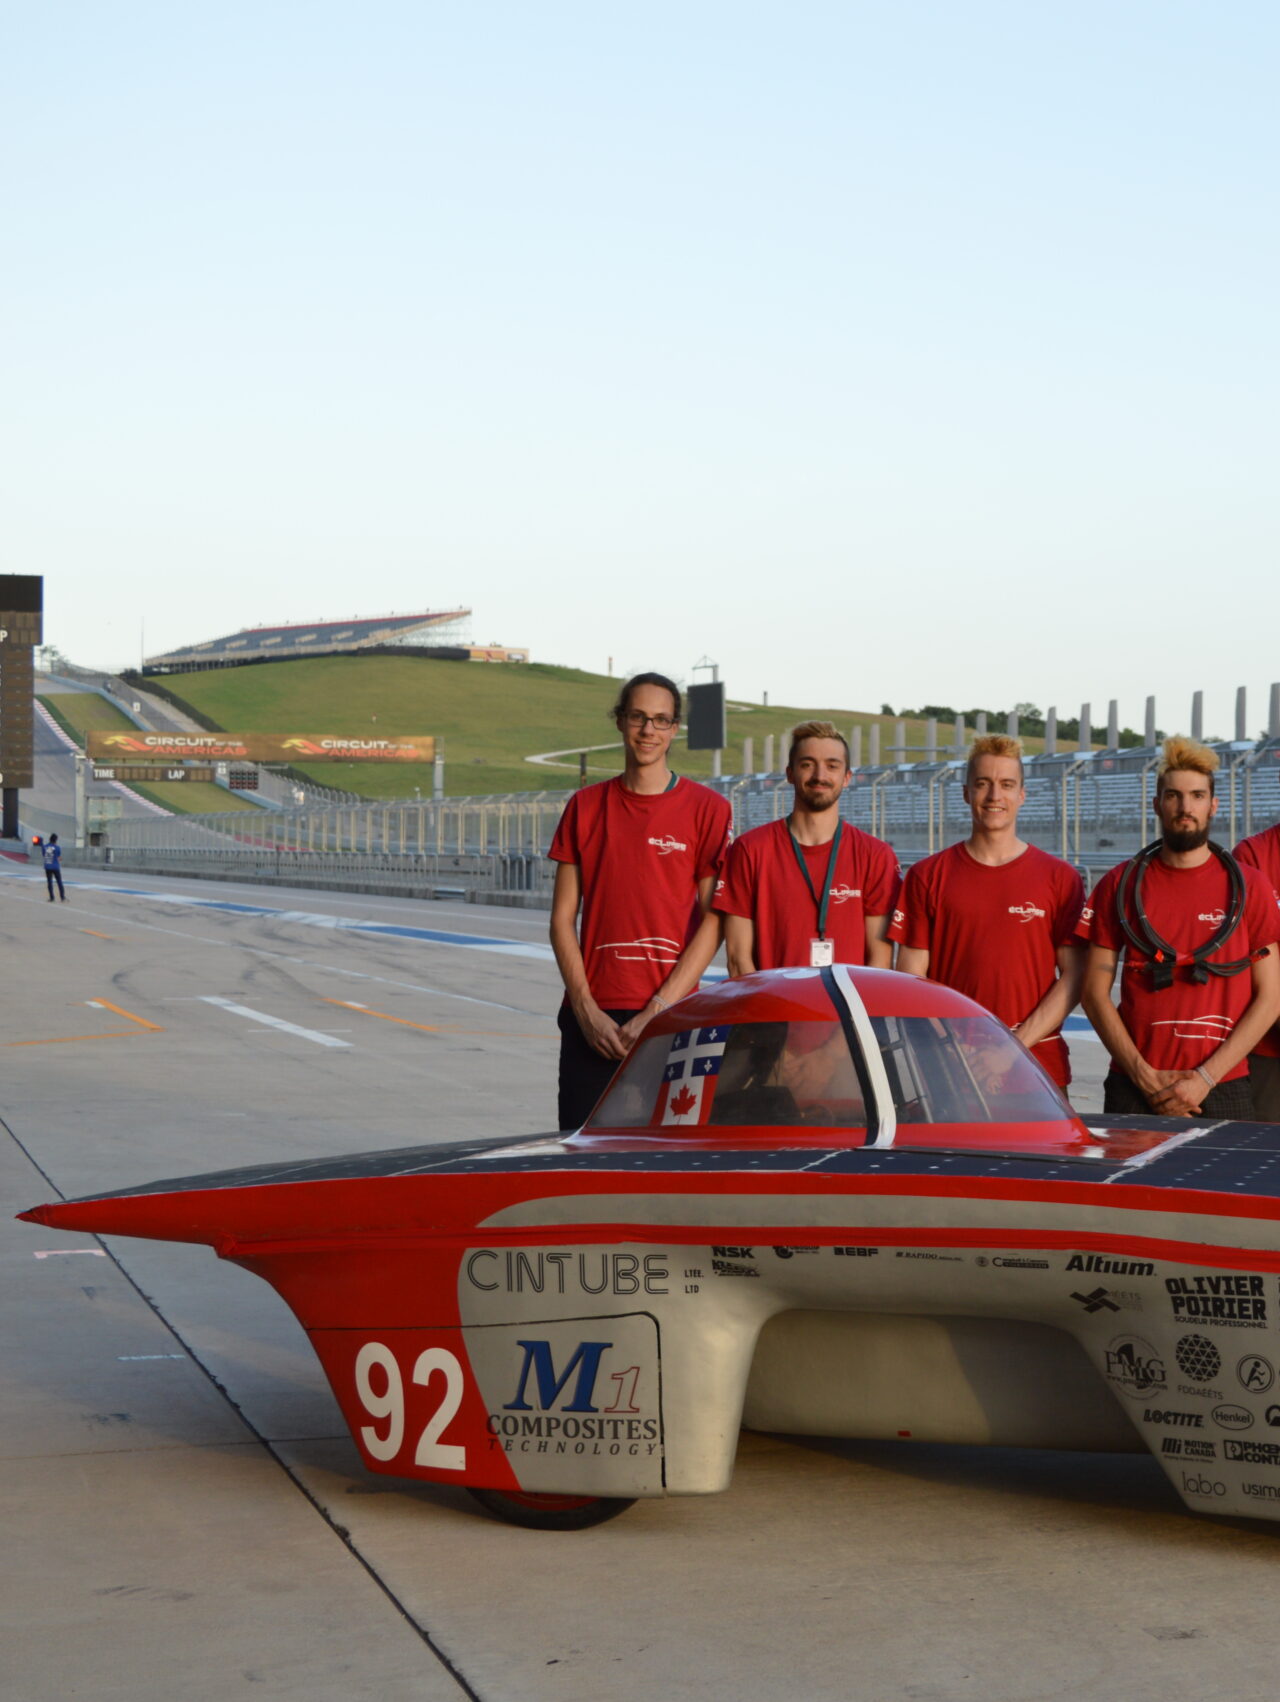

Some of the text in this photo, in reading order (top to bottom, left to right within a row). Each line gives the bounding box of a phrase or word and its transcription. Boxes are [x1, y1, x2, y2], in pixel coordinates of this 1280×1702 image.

[145, 736, 216, 746] CIRCUIT
[321, 739, 388, 749] CIRCUIT
[151, 746, 248, 756] AMERICAS
[328, 749, 419, 758] AMERICAS
[94, 769, 185, 779] TIME LAP
[712, 1247, 755, 1258] NSK
[1065, 1255, 1156, 1276] Altium
[468, 1250, 669, 1295] CINTUBE
[685, 1285, 699, 1294] LTD
[1165, 1276, 1264, 1296] OLIVIER
[1171, 1295, 1267, 1320] POIRIER
[1174, 1316, 1268, 1329] SOUDEUR PROFESSIONNEL
[355, 1341, 466, 1471] 92
[1144, 1409, 1203, 1427] LOCTITE
[1214, 1411, 1251, 1425] Henkel
[486, 1415, 657, 1440] COMPOSITES
[488, 1438, 657, 1455] TECHNOLOGY
[1185, 1440, 1216, 1449] MOTION
[1185, 1448, 1217, 1458] CANADA
[1182, 1472, 1226, 1496] labo
